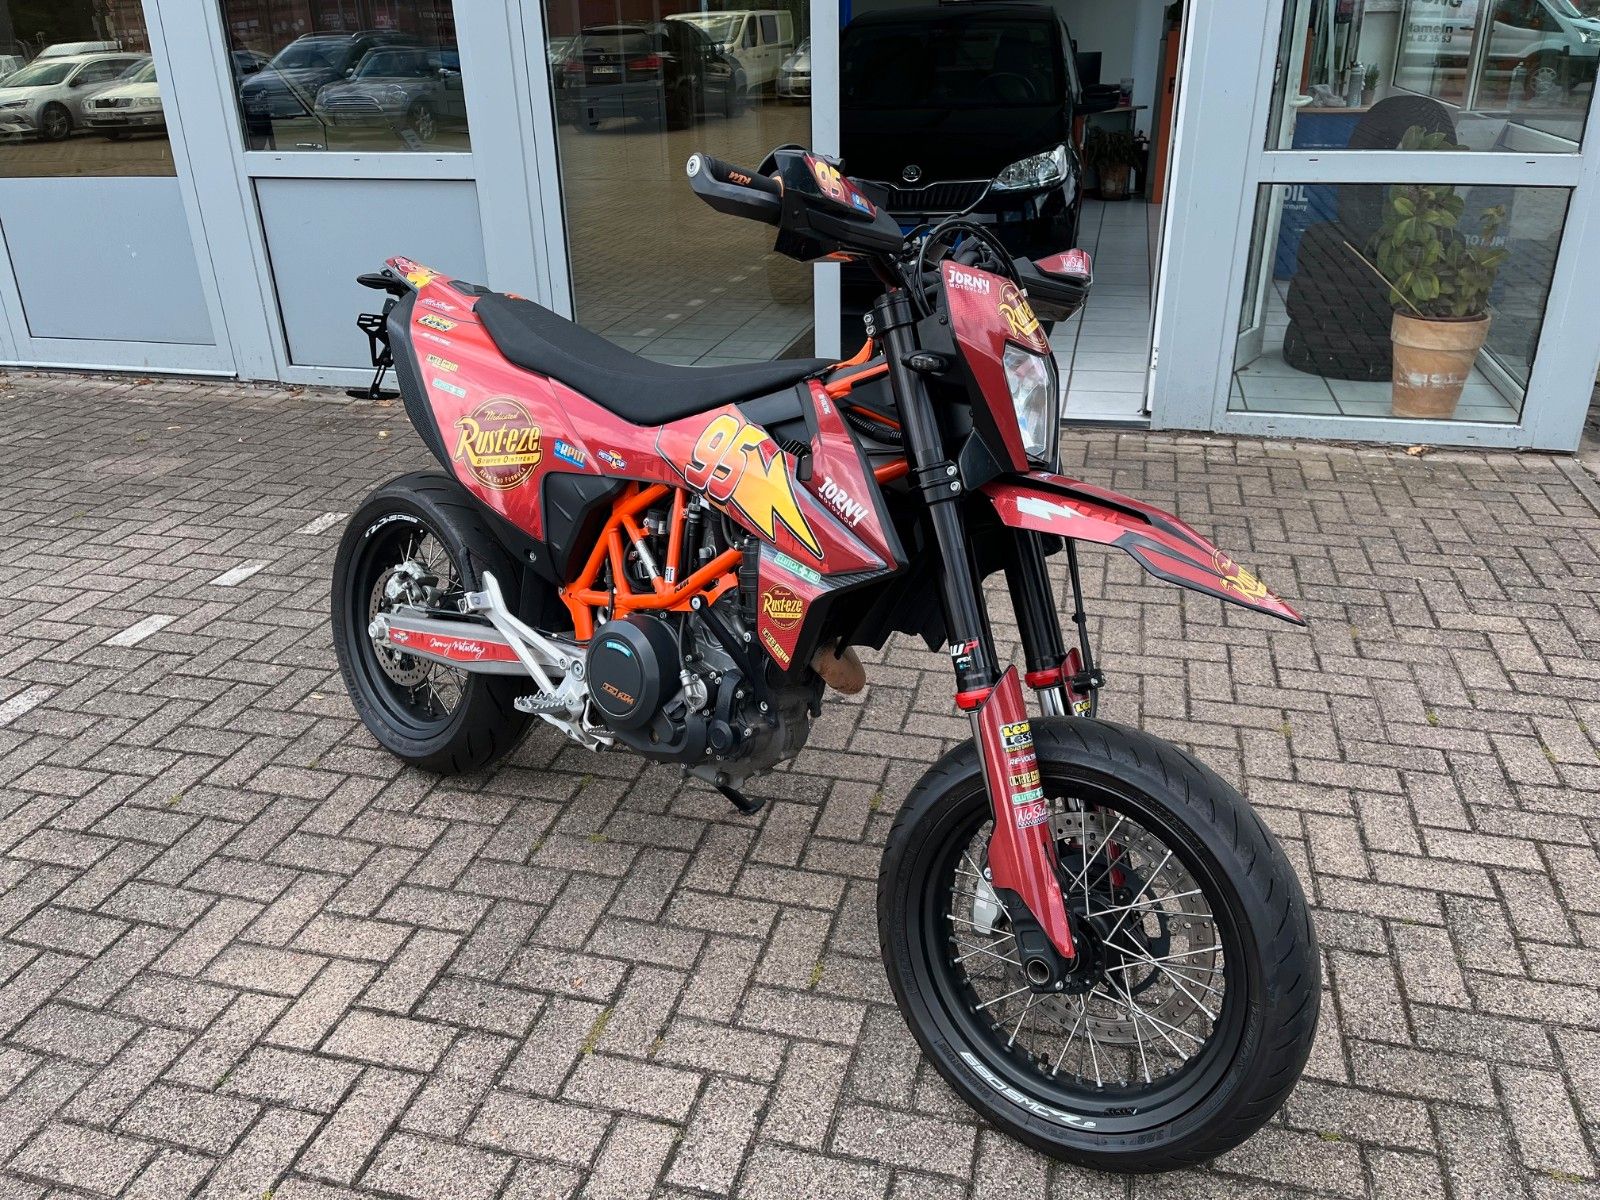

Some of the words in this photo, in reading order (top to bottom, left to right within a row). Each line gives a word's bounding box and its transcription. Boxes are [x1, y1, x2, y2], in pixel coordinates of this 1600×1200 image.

[948, 265, 990, 294] JORNY
[684, 413, 768, 501] 95
[818, 476, 869, 527] JORNY
[950, 639, 979, 657] WP
